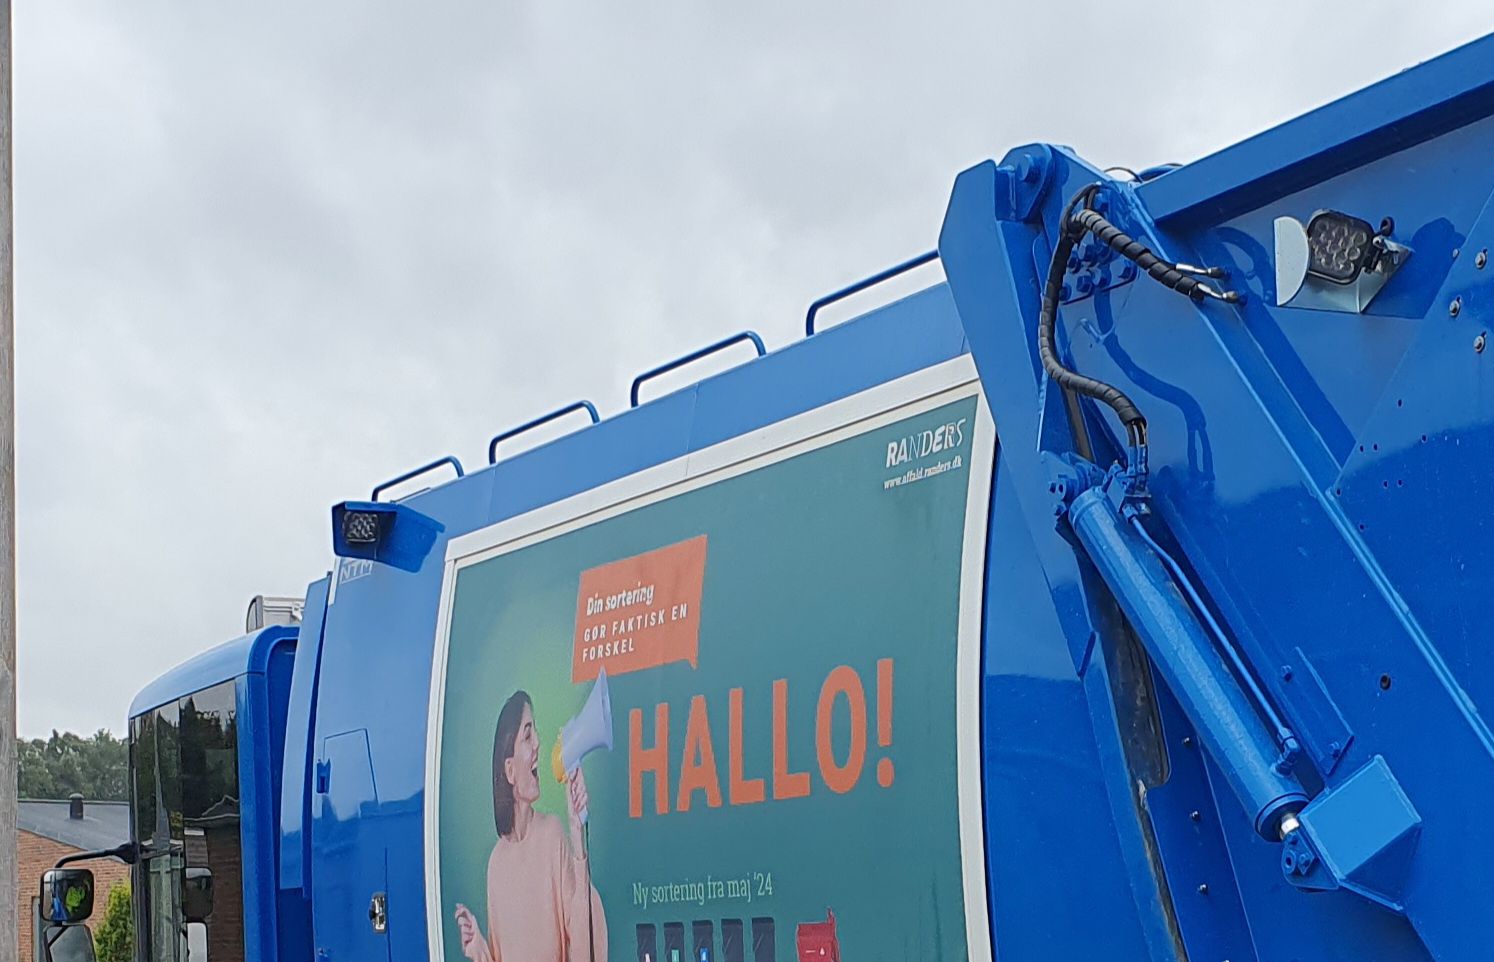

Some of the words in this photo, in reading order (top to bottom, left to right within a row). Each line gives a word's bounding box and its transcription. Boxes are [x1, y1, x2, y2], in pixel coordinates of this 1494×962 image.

[886, 418, 967, 468] RANDERS
[586, 592, 604, 616] Din
[604, 581, 655, 610] sortering
[584, 624, 607, 642] GØR
[612, 609, 665, 636] FAKTISK
[671, 603, 688, 620] EN
[582, 638, 635, 662] FORSKEL
[628, 658, 895, 818] HALLO!
[632, 882, 649, 909] Ny
[652, 878, 705, 906] sortering
[707, 875, 724, 899] fra
[727, 872, 751, 903] maj
[753, 872, 773, 896] '24
